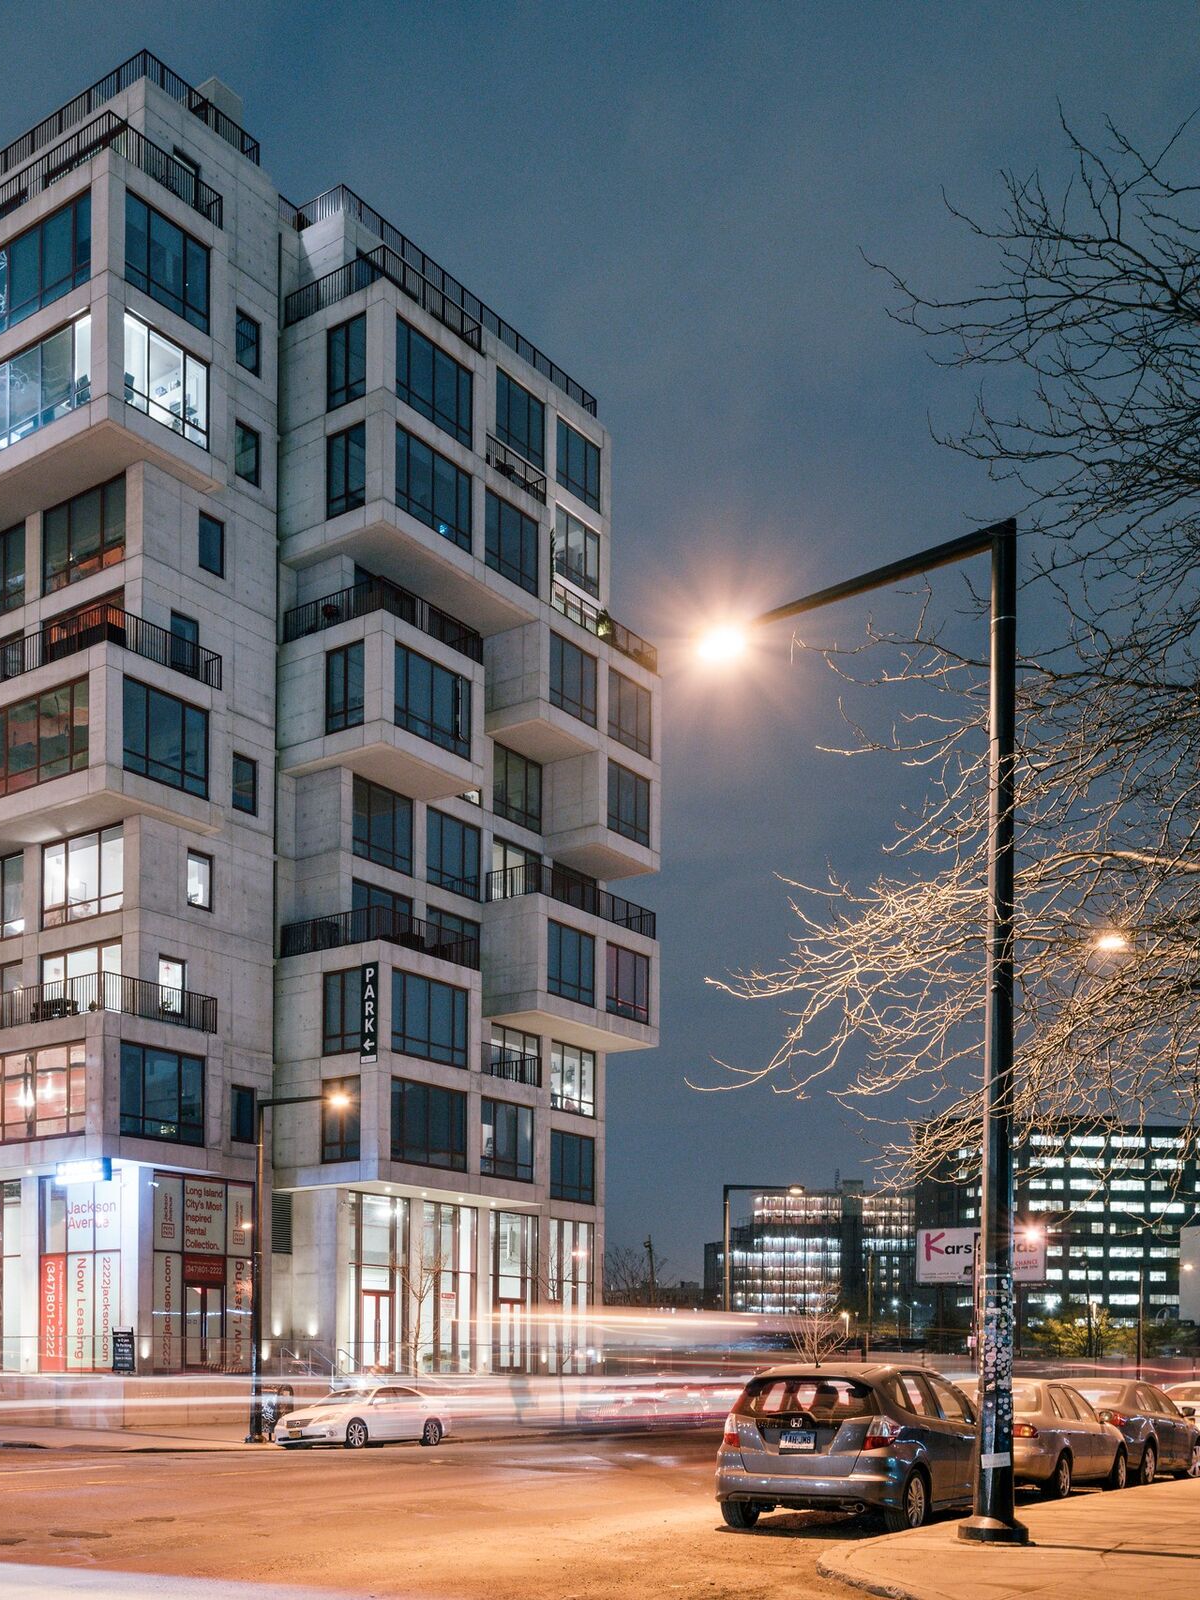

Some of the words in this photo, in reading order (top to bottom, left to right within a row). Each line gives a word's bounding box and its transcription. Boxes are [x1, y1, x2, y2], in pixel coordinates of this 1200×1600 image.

[364, 967, 375, 1033] PARK
[186, 1186, 202, 1198] Long
[204, 1188, 223, 1198] Island
[67, 1200, 117, 1214] Jackson
[186, 1199, 204, 1211] City's
[206, 1201, 223, 1211] Most
[186, 1213, 212, 1224] Inspired
[186, 1225, 207, 1236] Rental
[186, 1238, 220, 1250] Collection.
[76, 1258, 87, 1293] Now
[45, 1261, 56, 1358] (347)801-2222
[101, 1257, 111, 1362] 2222jackson.com
[74, 1298, 86, 1360] Leasing
[232, 1329, 242, 1365] Now
